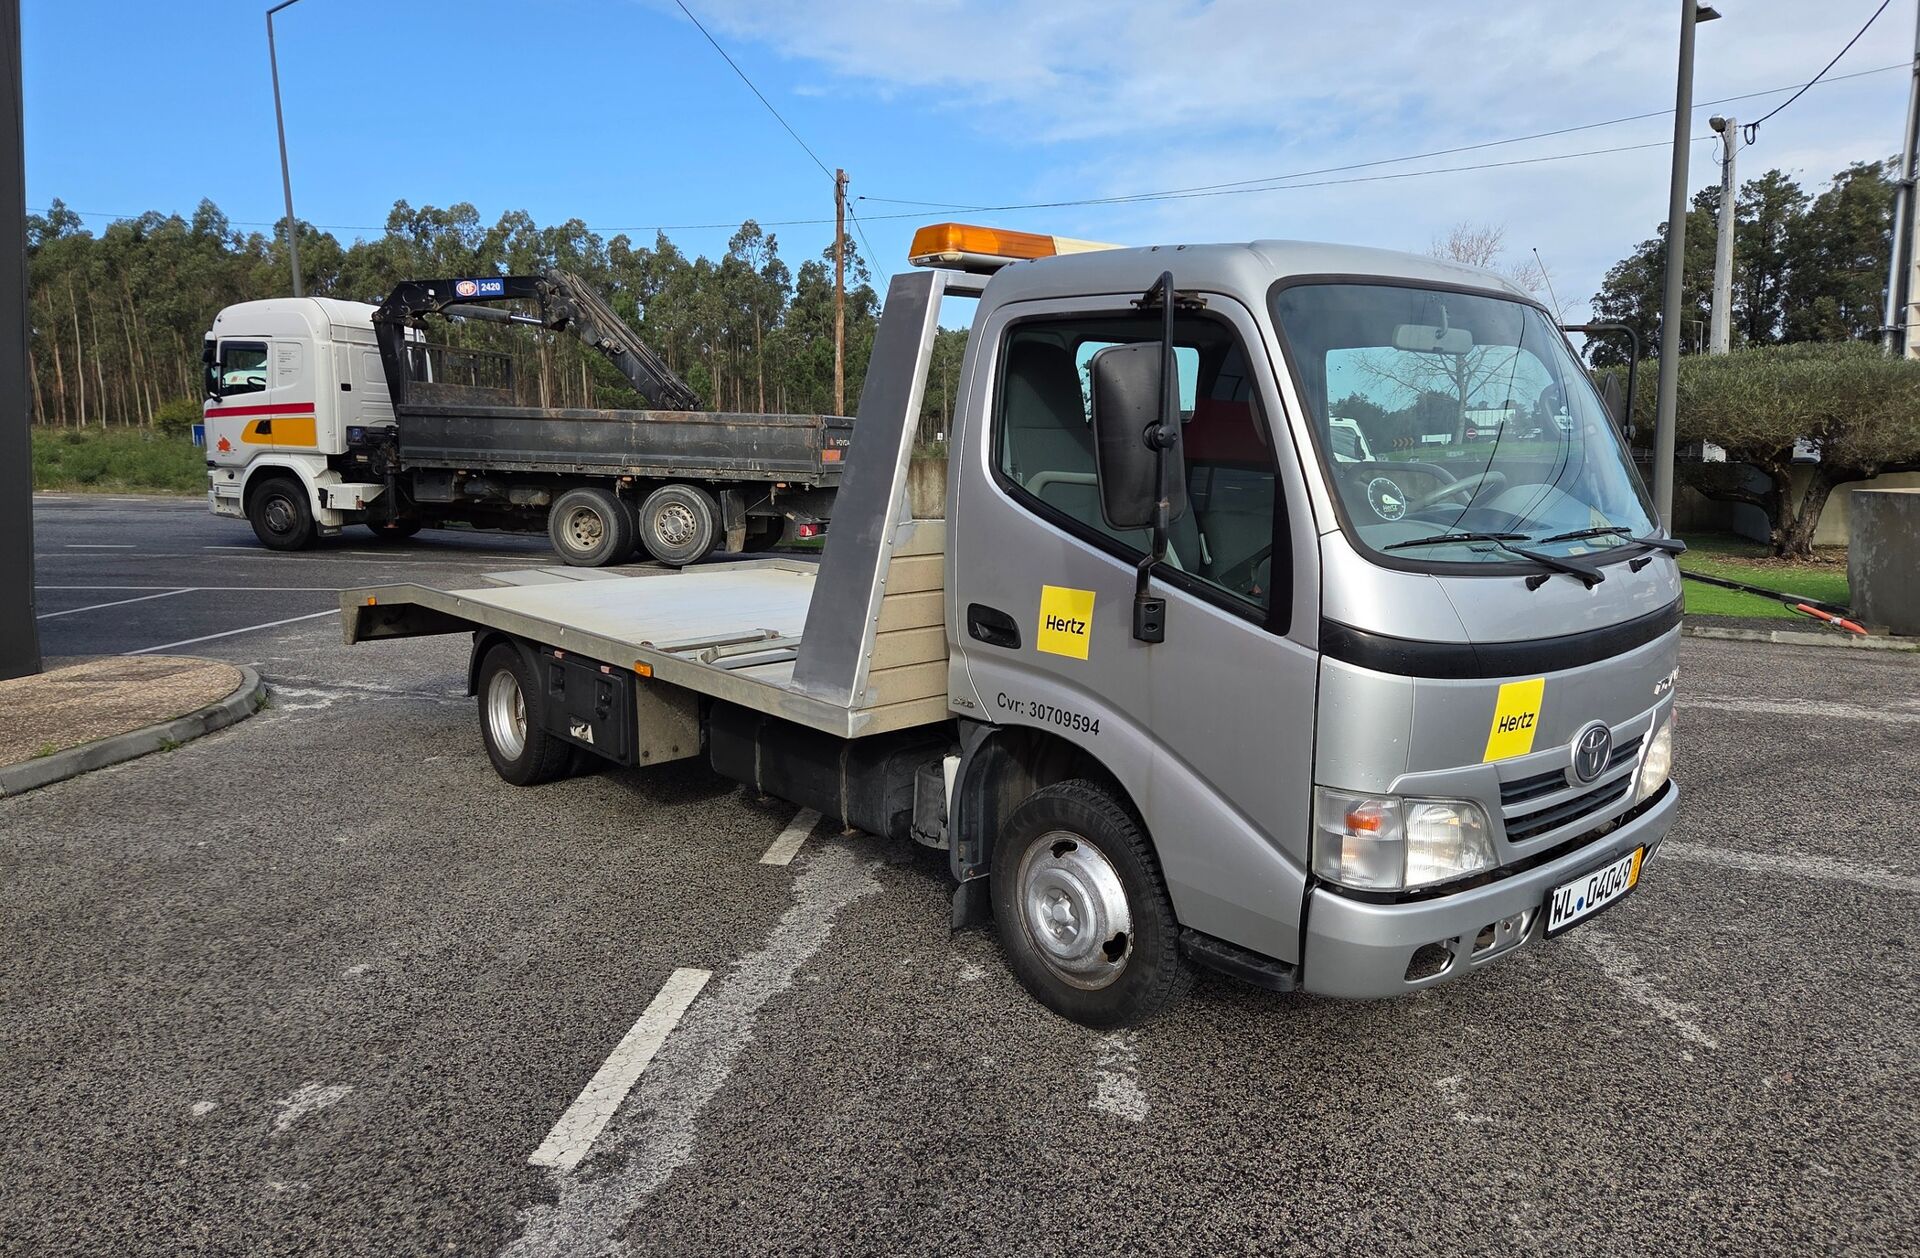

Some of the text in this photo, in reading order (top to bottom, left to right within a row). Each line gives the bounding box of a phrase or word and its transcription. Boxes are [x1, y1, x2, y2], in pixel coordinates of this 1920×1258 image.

[480, 282, 500, 291] 2420
[1045, 614, 1085, 635] Hertz
[997, 692, 1025, 714] Cvr:
[1028, 701, 1100, 735] 30709594
[1497, 711, 1535, 734] Hertz
[1552, 888, 1575, 925] WL
[1585, 858, 1632, 908] 04049
